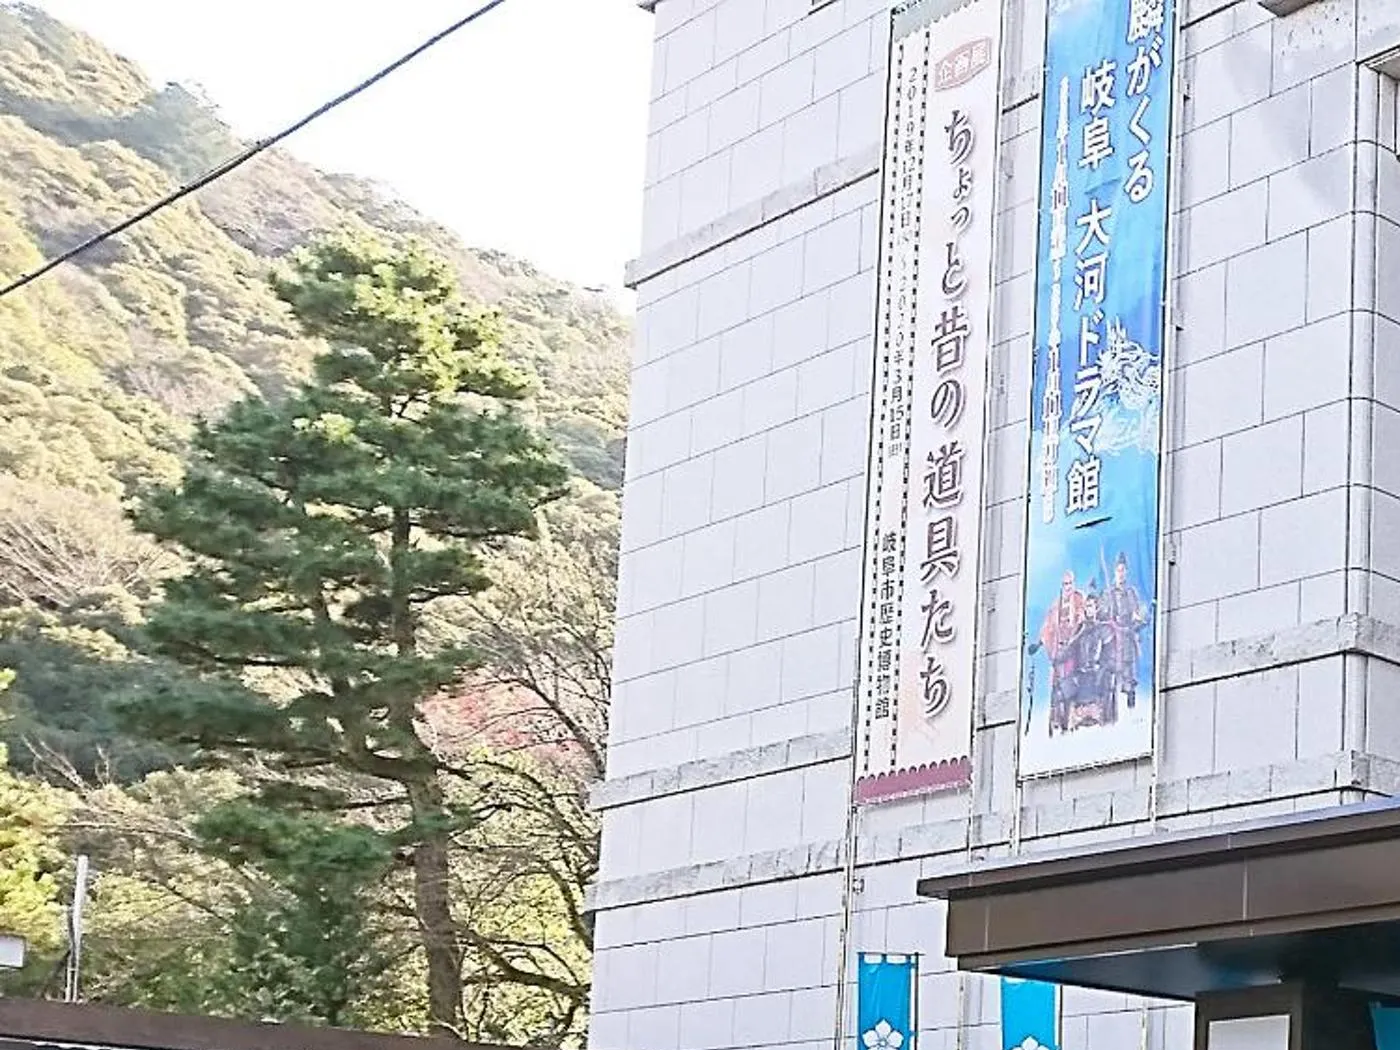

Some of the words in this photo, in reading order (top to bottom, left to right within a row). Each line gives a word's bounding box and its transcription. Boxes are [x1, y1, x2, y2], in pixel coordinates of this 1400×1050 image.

[918, 109, 975, 716] ちょっと昔の道具たち
